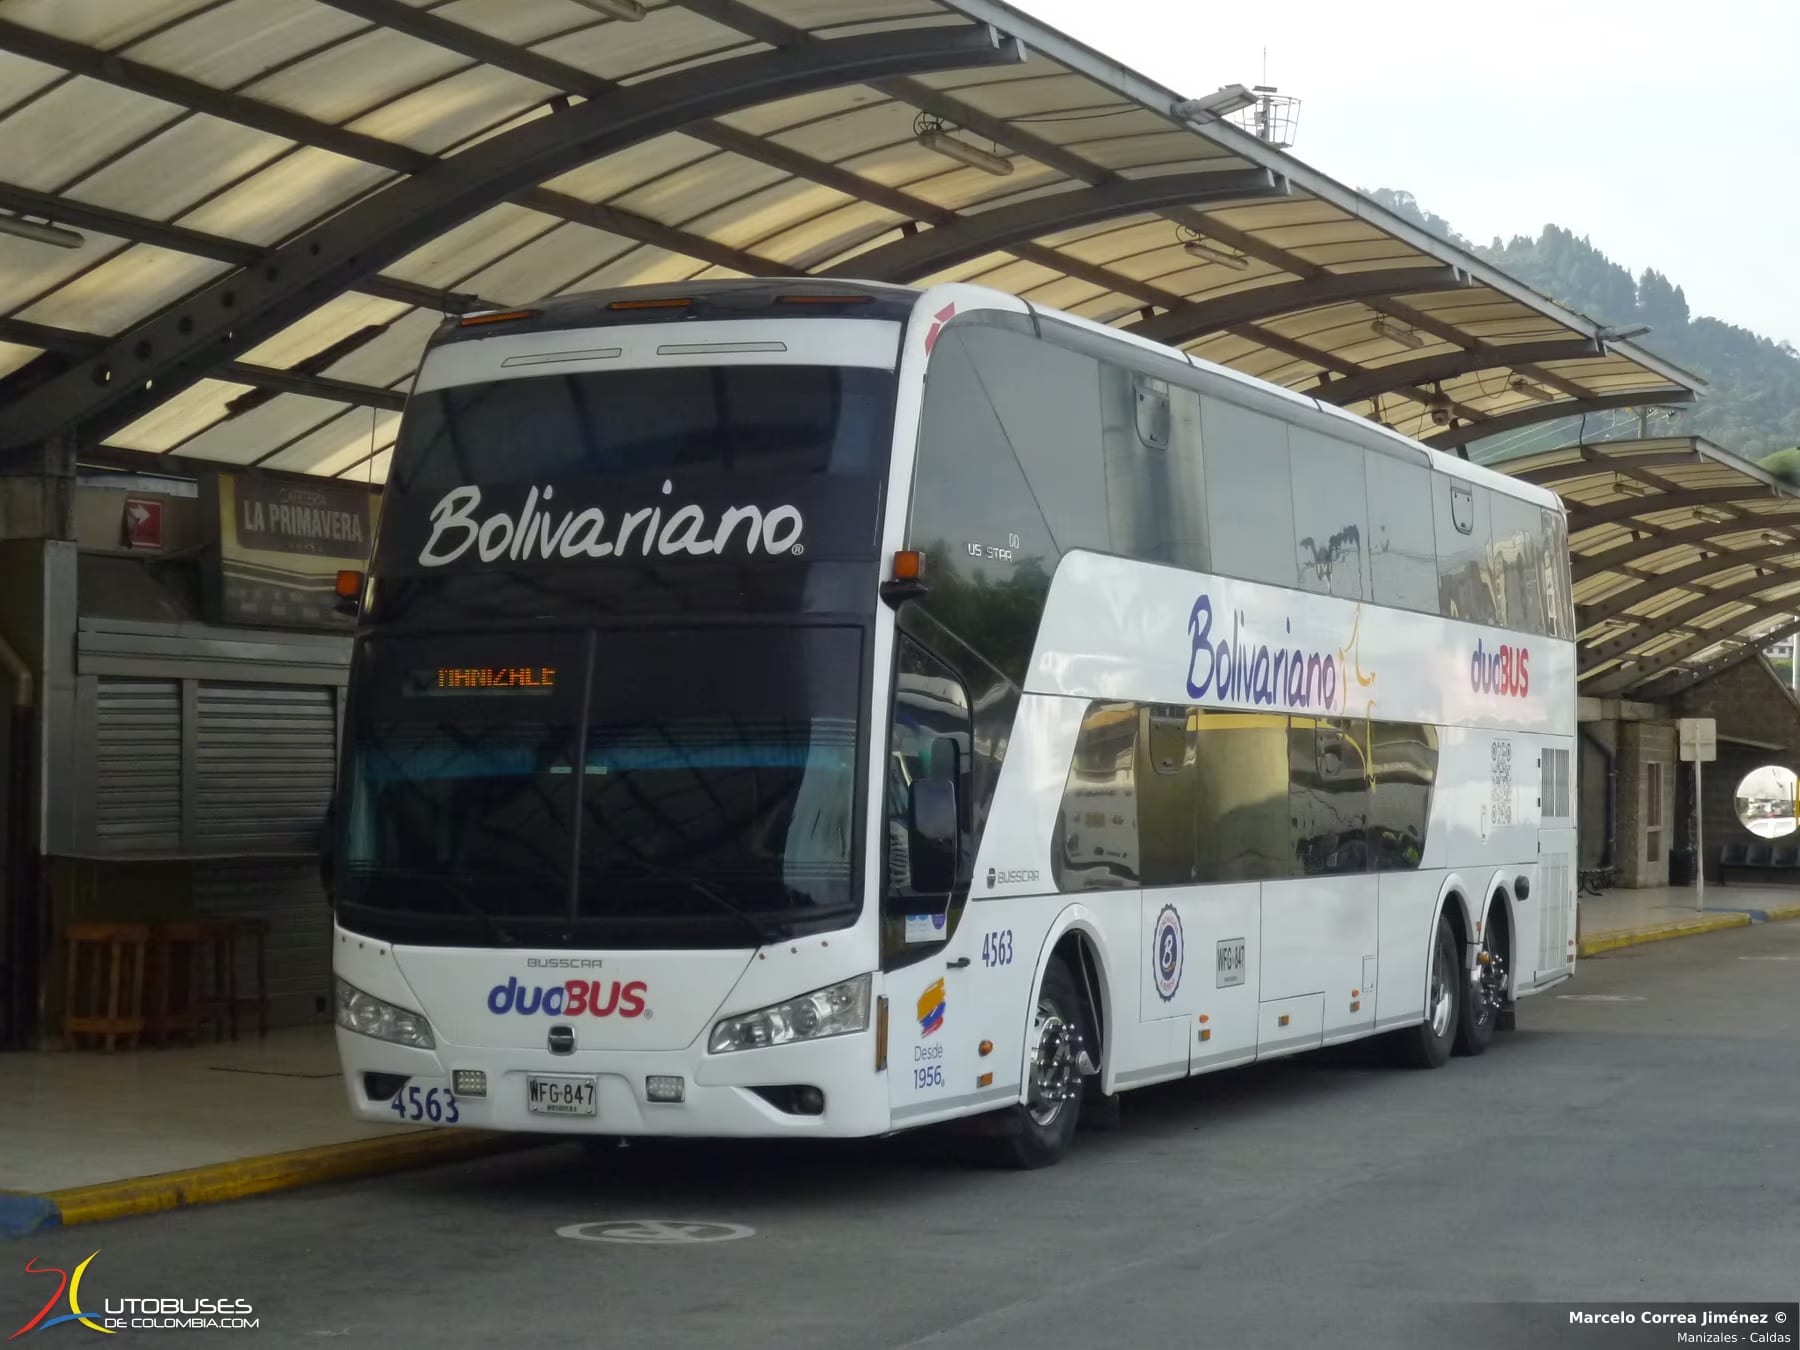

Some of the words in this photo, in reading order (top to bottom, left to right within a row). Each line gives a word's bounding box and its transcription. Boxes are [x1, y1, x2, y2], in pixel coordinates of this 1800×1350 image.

[243, 500, 264, 531] LA
[270, 503, 363, 543] PRIMAVERA
[419, 479, 804, 567] Bolivariano
[1186, 594, 1335, 710] Bolivariano
[1471, 639, 1529, 698] duoBUS
[998, 870, 1040, 884] BUSSCAR
[527, 957, 602, 969] BUSSCAR
[982, 930, 1013, 967] 4563
[487, 975, 648, 1018] duoBUS
[914, 1042, 943, 1062] Desde
[913, 1065, 942, 1090] 1956
[391, 1087, 460, 1123] 4563
